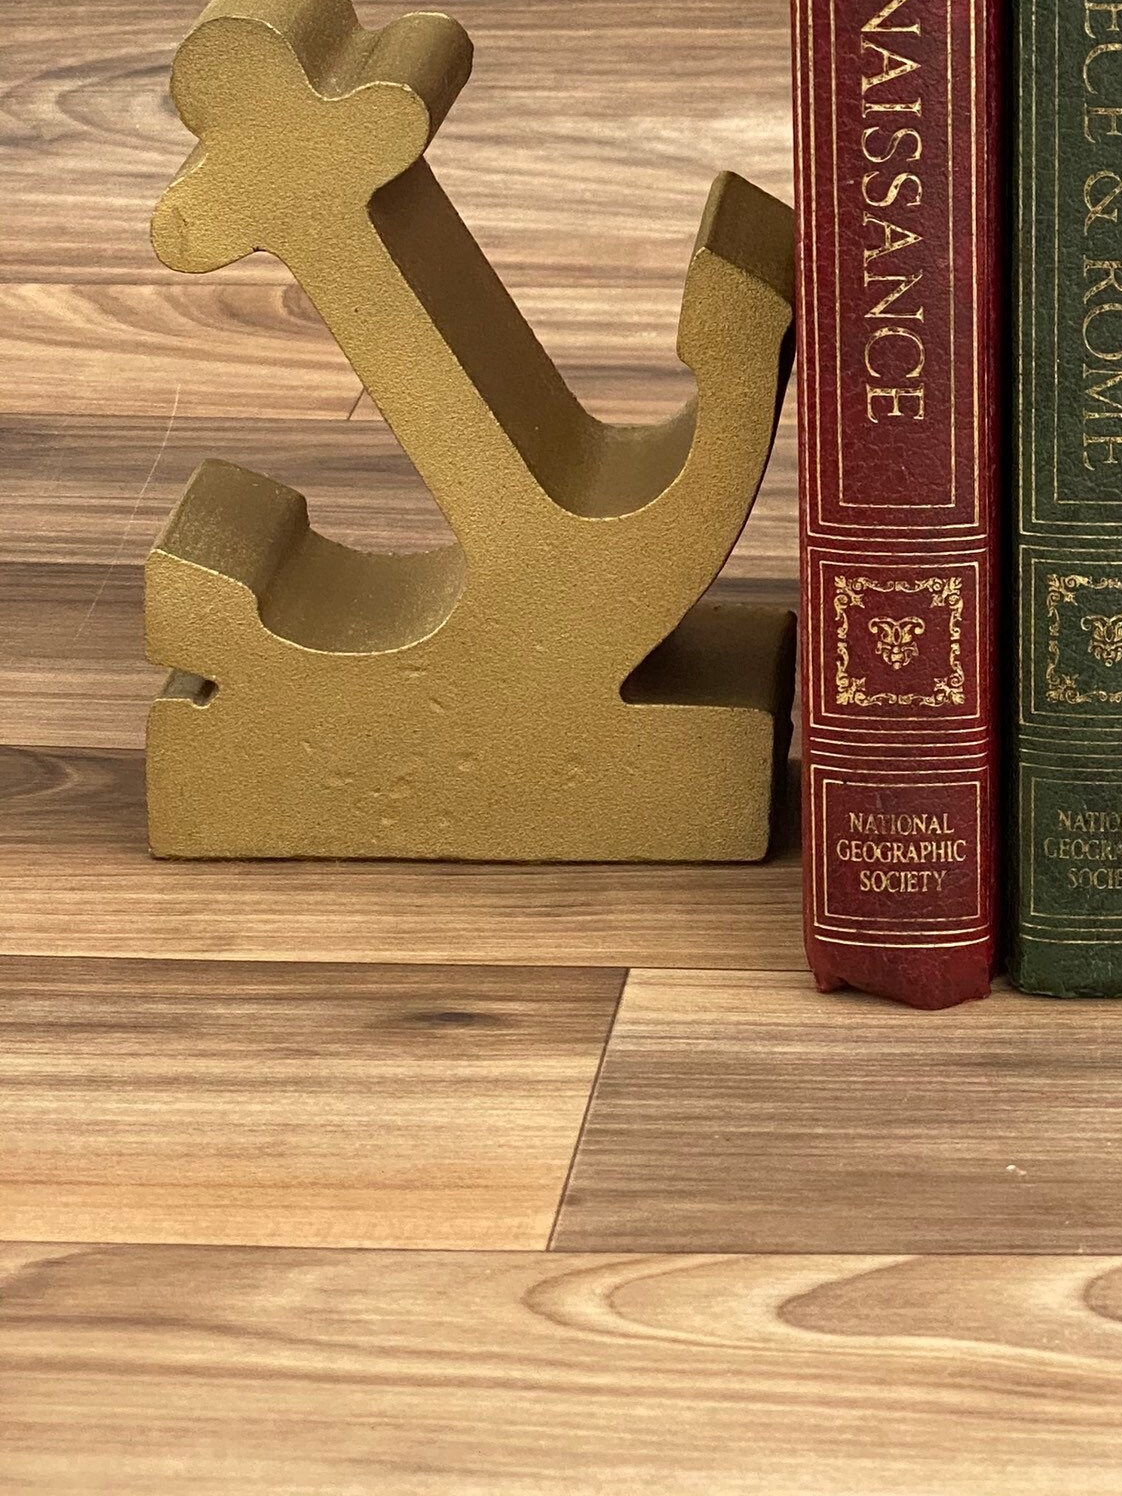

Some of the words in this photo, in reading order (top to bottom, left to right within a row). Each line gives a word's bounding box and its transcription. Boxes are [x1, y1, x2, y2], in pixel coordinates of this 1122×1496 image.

[849, 813, 955, 835] NATIONAL
[836, 839, 967, 864] GEOGRAPHIC
[859, 869, 948, 893] SOCIETY
